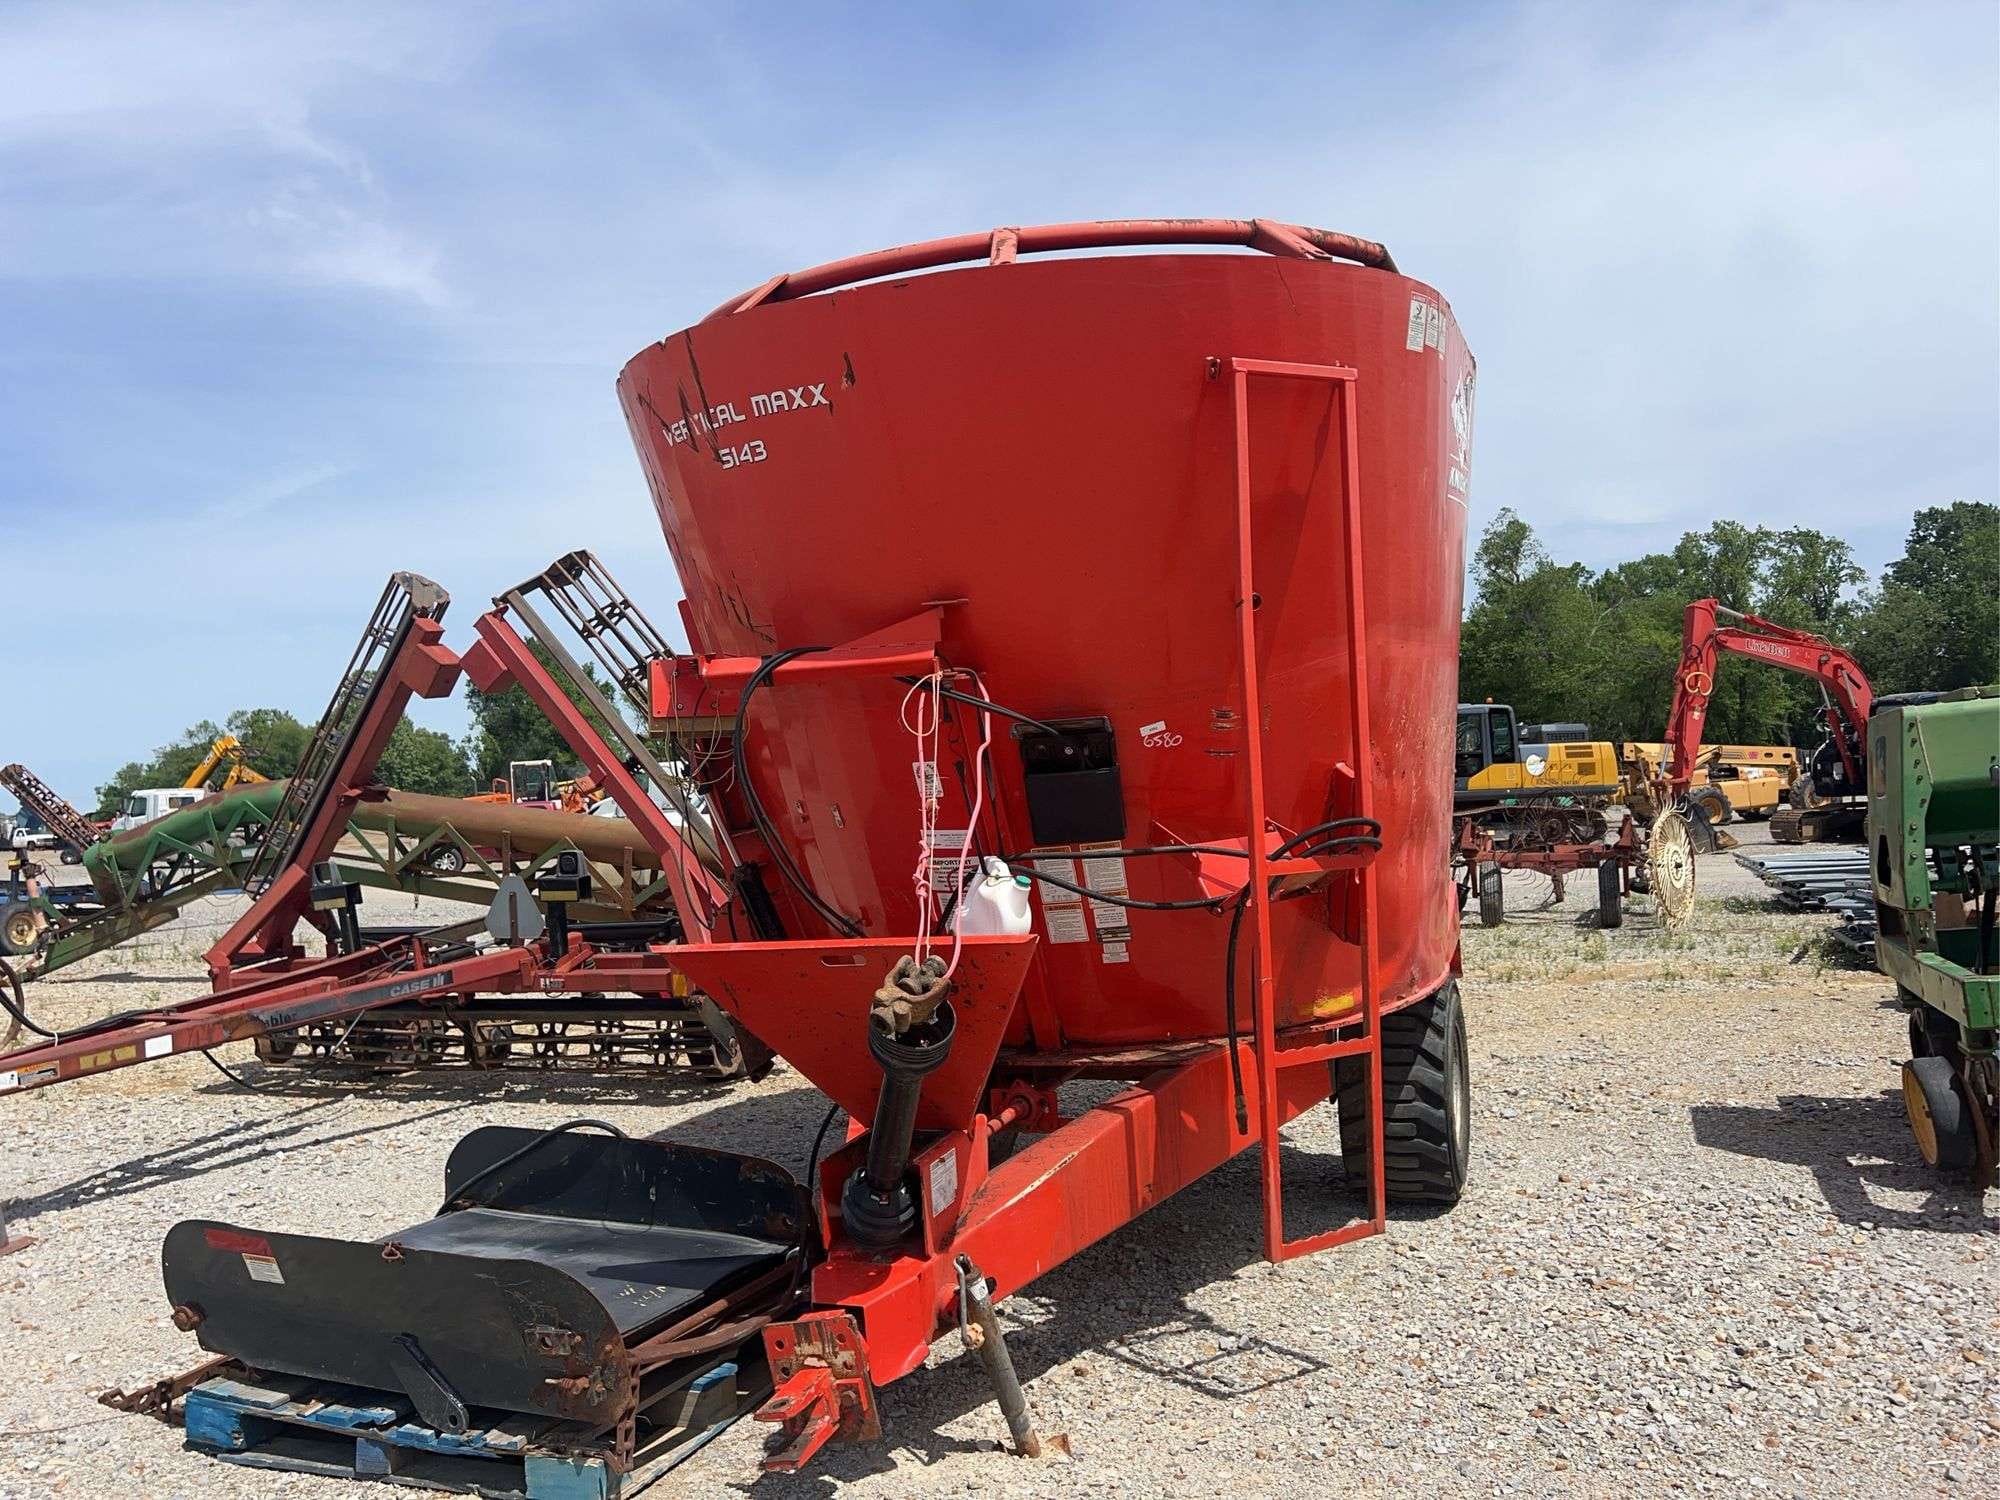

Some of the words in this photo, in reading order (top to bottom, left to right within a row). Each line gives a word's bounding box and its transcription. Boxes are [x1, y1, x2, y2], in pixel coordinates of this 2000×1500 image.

[662, 402, 746, 448] VERTICAL
[751, 382, 831, 418] MAXX
[718, 440, 768, 470] 5143
[1143, 731, 1183, 748] 6580
[390, 979, 430, 997] CASE
